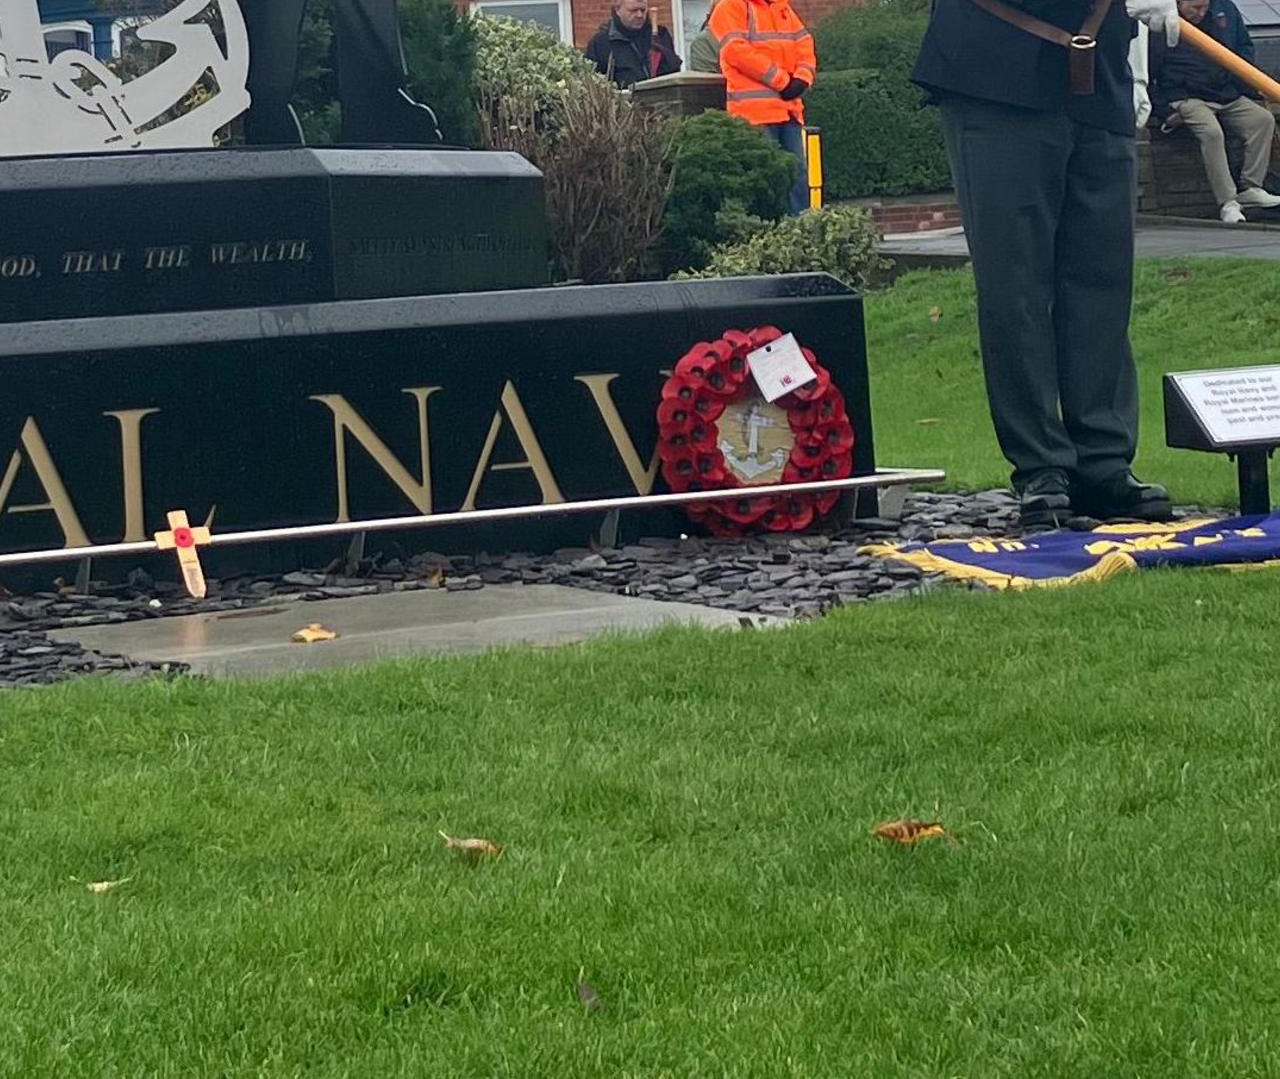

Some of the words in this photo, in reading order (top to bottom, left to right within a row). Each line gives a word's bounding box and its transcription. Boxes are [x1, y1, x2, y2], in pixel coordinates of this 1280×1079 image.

[63, 251, 124, 274] THAT
[143, 245, 190, 268] THE
[309, 371, 674, 524] NAV
